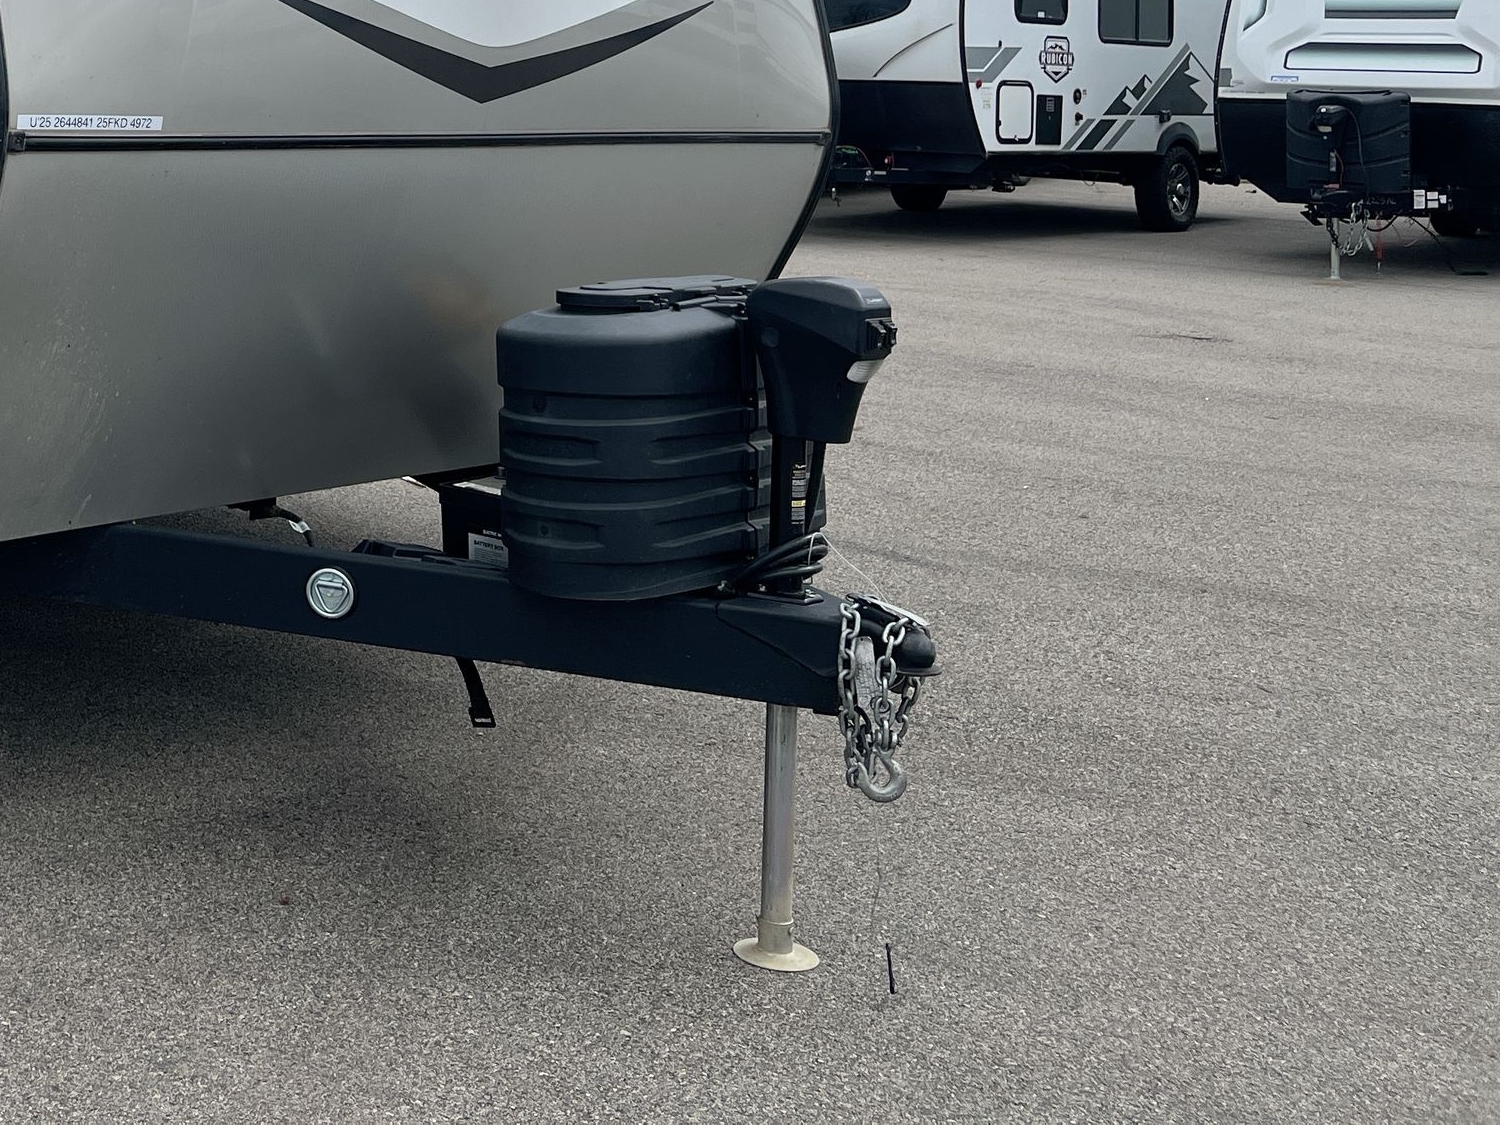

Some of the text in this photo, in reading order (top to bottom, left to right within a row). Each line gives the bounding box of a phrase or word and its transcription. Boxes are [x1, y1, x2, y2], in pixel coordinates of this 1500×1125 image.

[1040, 51, 1073, 66] RUBICON
[53, 117, 93, 128] 2644841
[96, 117, 128, 128] 25FKD
[129, 118, 153, 129] 4972
